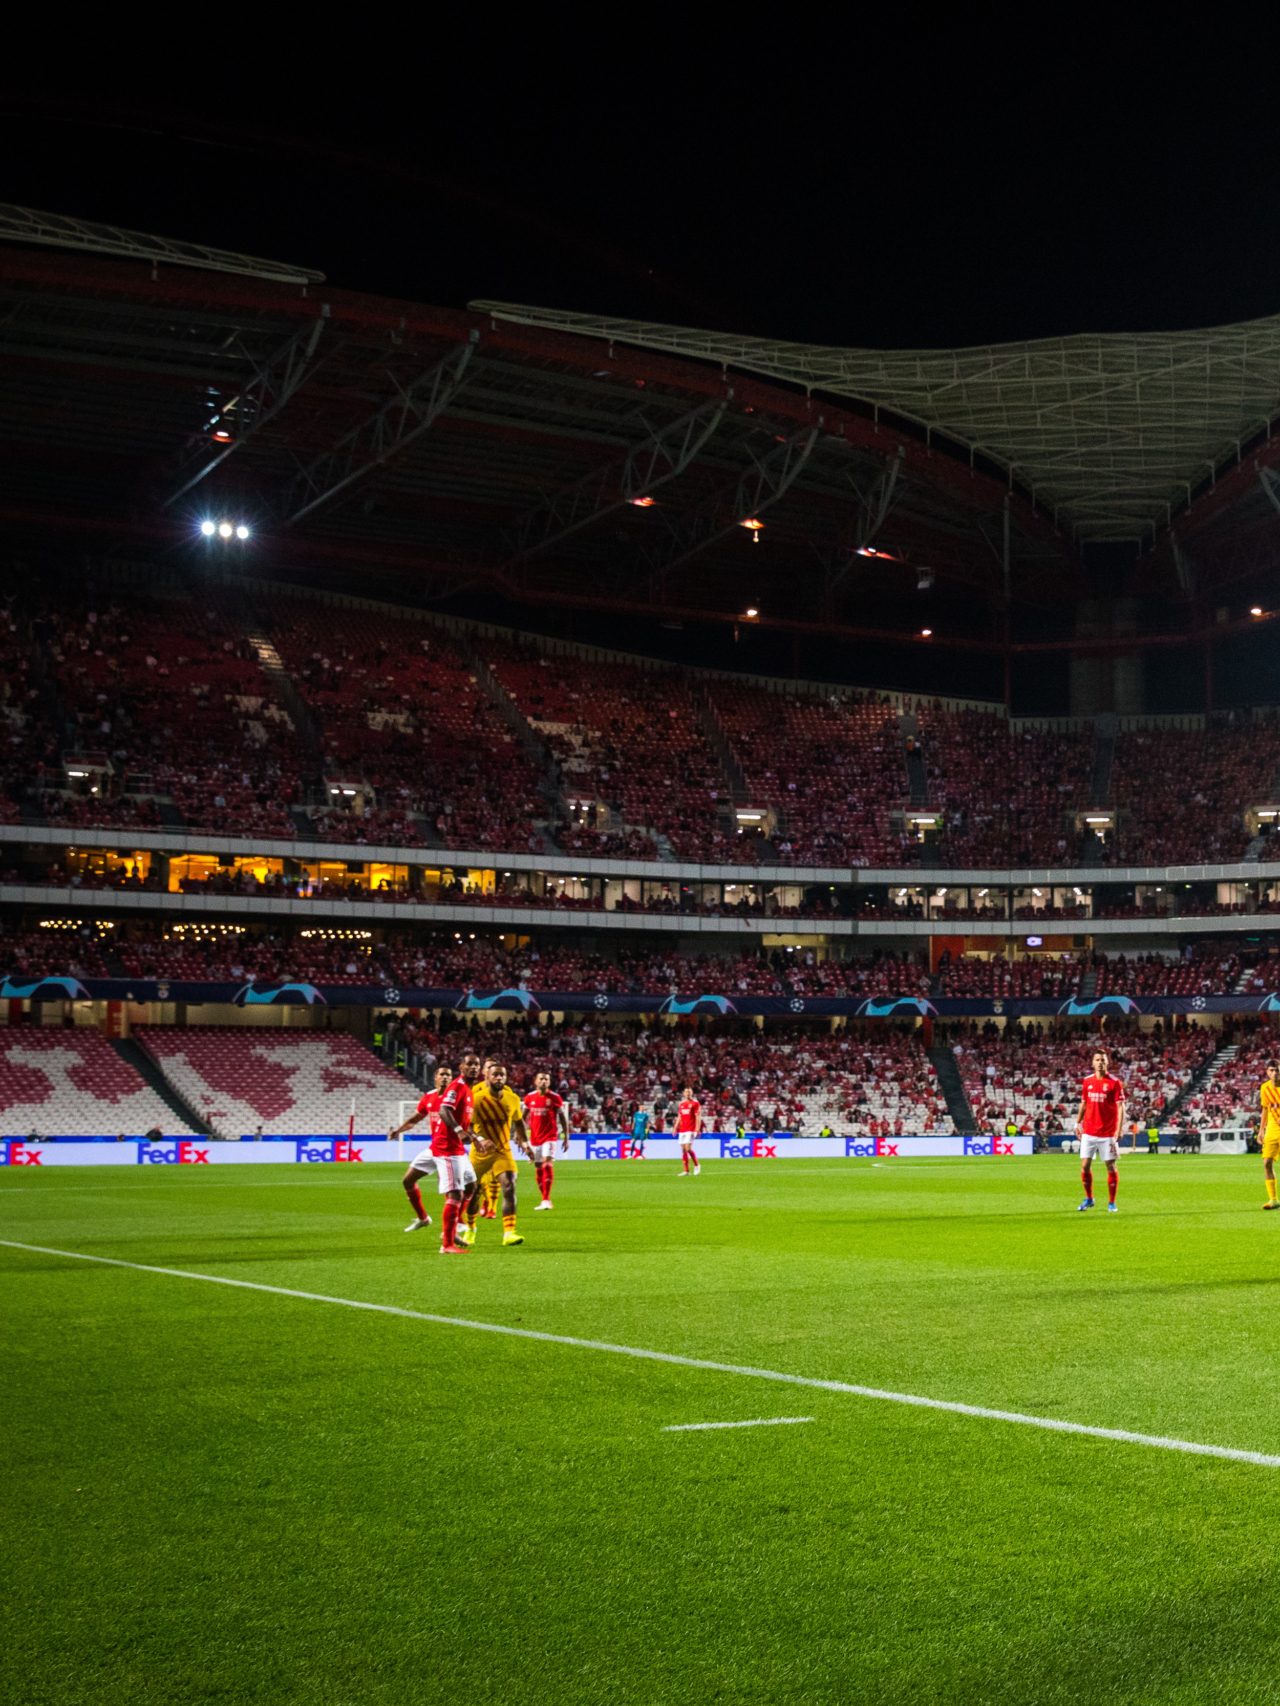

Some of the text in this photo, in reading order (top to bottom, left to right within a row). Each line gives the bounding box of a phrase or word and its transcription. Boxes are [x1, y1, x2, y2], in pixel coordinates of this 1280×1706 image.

[137, 1141, 209, 1165] FedEx
[296, 1141, 363, 1163] FedEx
[720, 1139, 777, 1158] FedEx
[845, 1137, 899, 1157] FedEx
[963, 1136, 1015, 1155] FedEx
